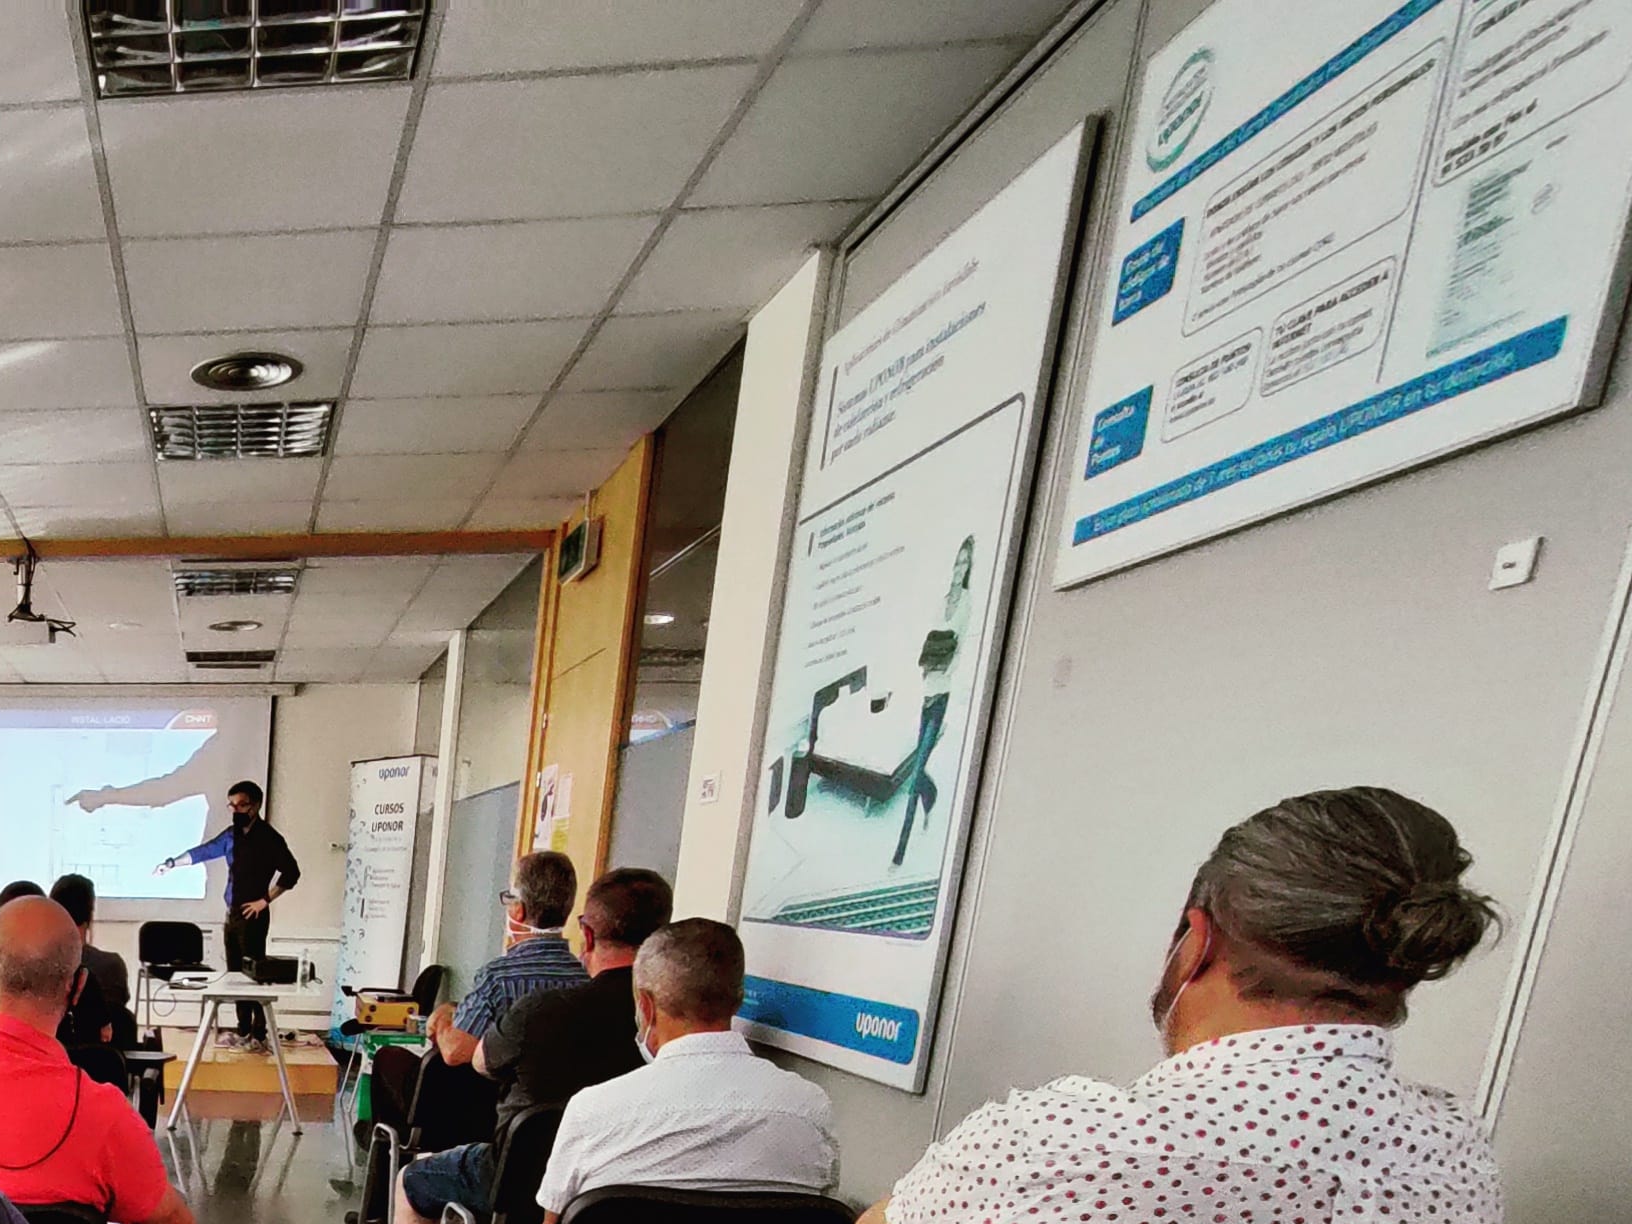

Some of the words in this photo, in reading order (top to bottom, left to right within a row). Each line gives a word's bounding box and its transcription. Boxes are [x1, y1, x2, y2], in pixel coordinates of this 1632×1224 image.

[379, 766, 410, 781] uponor
[374, 803, 404, 816] CURSOS
[371, 820, 404, 833] UPONOR
[855, 1011, 902, 1043] uponor
